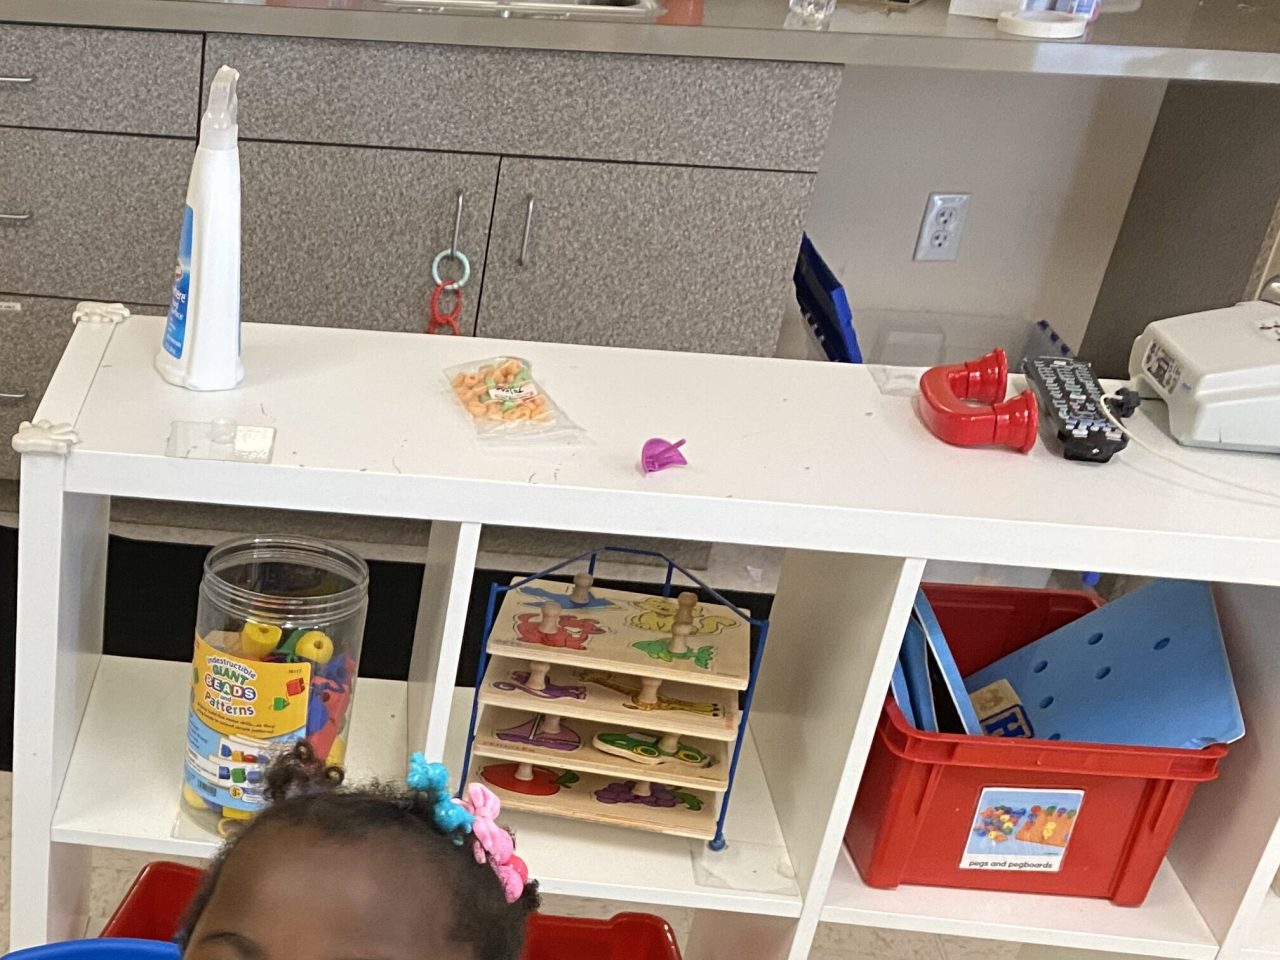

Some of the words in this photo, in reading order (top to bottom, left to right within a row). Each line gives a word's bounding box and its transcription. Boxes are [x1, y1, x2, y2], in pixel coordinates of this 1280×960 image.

[212, 664, 249, 685] GIANT
[205, 673, 256, 700] BEADS
[204, 691, 254, 716] Patterns
[220, 694, 232, 702] and
[969, 860, 989, 868] pegs
[1007, 861, 1053, 869] pegboards
